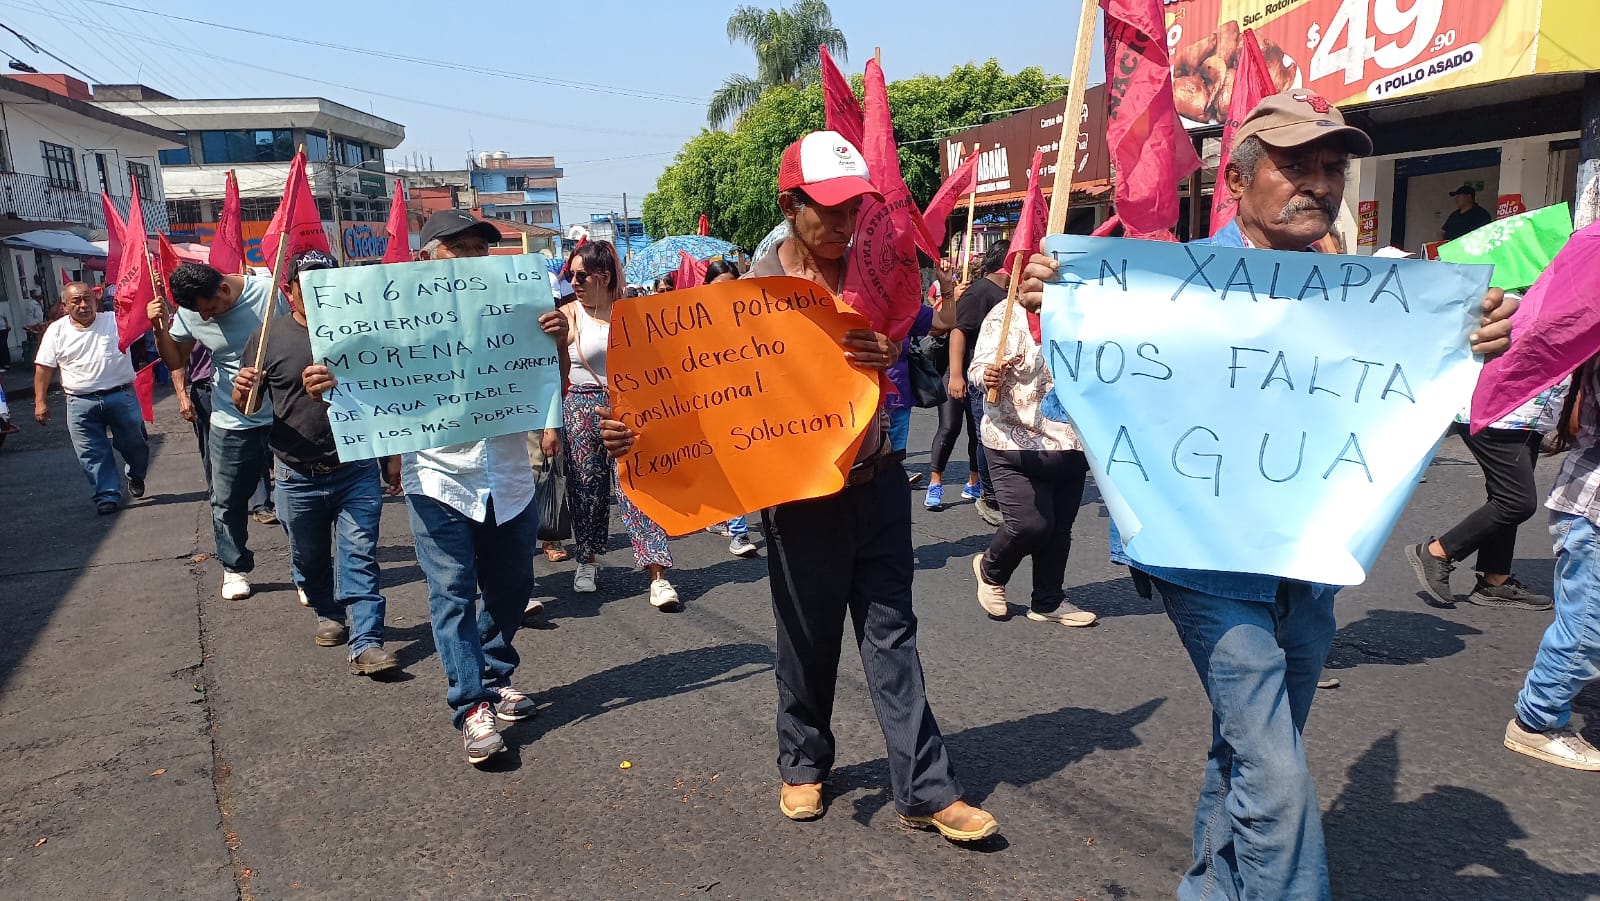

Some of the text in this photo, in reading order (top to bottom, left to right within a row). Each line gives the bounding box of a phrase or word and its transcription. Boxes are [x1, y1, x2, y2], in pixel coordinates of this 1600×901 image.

[1243, 0, 1301, 26] Suc. Roton
[1375, 50, 1474, 95] 1 POLLO ASADO
[977, 142, 1009, 181] ABAÑA
[383, 279, 400, 301] 6
[417, 276, 488, 297] AÑOS
[505, 270, 542, 285] LOS
[1051, 245, 1411, 314] EN XALAPA
[315, 303, 515, 342] GOBIERNOS DE
[646, 301, 713, 343] AGUA
[732, 289, 833, 327] potable
[323, 333, 515, 370] MORENA NO
[613, 336, 785, 393] es un derecho
[1049, 339, 1416, 404] NOS FALTA
[328, 354, 559, 402] ATENDIERON LA CARENCIA
[333, 382, 522, 423] DE AGUA POTABLE
[342, 404, 539, 446] DE LOS MÁS POBRES
[1105, 425, 1374, 497] AGUA
